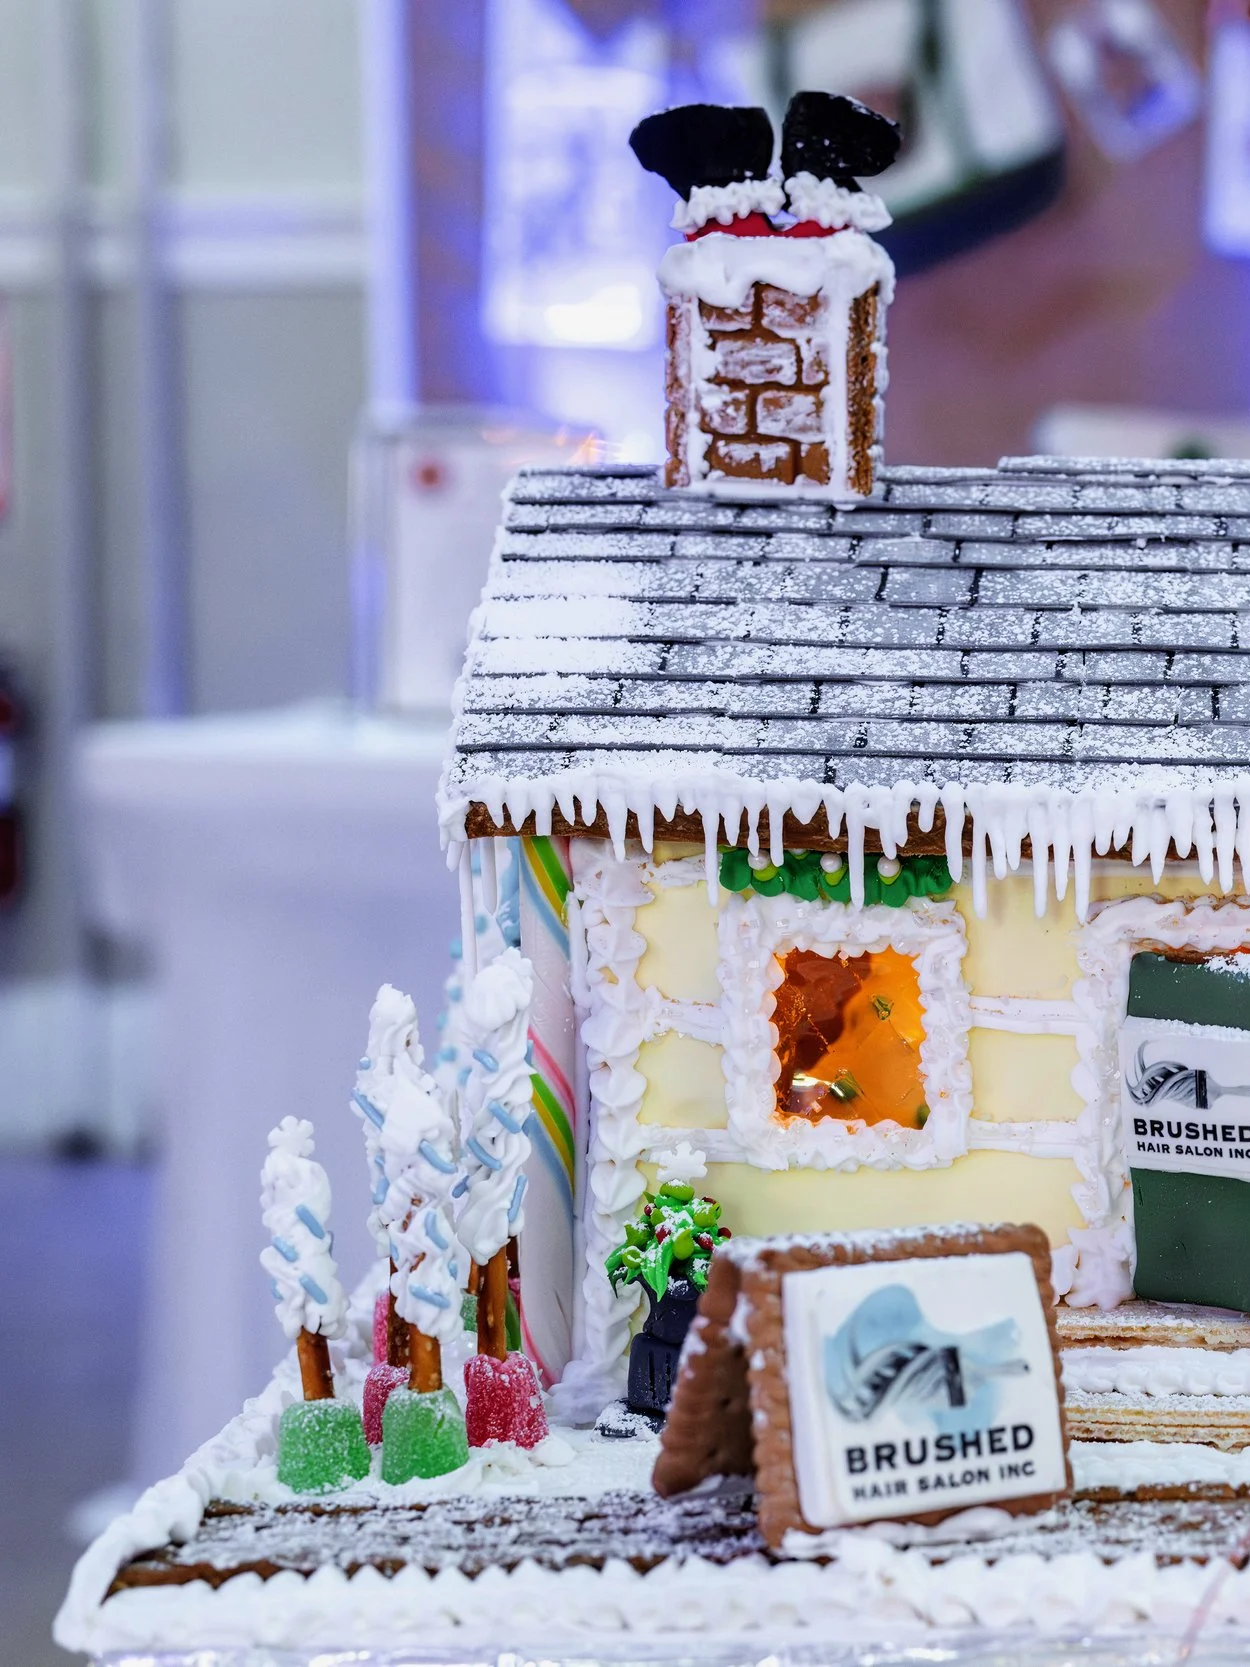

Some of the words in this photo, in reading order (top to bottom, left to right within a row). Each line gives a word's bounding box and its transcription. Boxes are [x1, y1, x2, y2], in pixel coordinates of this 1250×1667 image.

[1137, 1141, 1171, 1154] HAIR
[1175, 1144, 1223, 1158] SALON
[845, 1424, 1035, 1475] BRUSHED
[852, 1480, 908, 1501] HAIR
[918, 1469, 990, 1493] SALON
[999, 1461, 1036, 1480] INC
